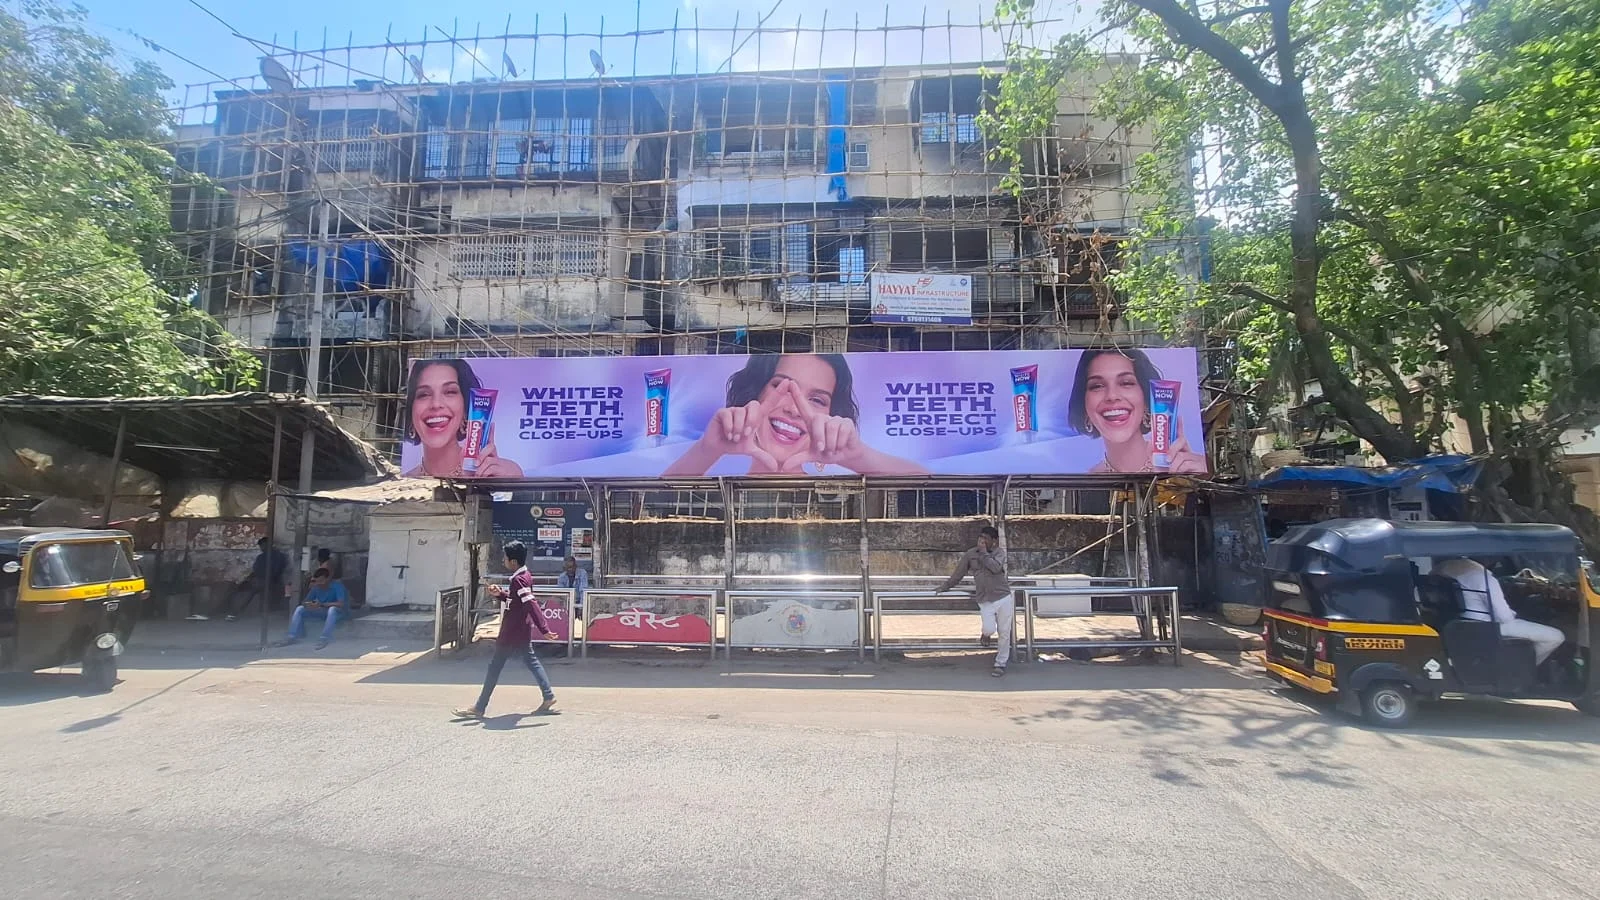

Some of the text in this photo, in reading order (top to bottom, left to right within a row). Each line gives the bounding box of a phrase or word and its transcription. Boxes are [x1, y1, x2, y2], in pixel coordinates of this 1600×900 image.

[879, 284, 917, 296] HAYYAT
[521, 387, 624, 399] WHITER
[885, 383, 995, 395] WHITER
[648, 400, 659, 433] closeup
[1017, 396, 1027, 429] closeup
[519, 417, 624, 430] PERFECT
[885, 413, 996, 425] PERFECT
[519, 430, 623, 440] CLOSE-UPS
[886, 427, 997, 437] CLOSE-UPS
[1155, 415, 1167, 451] closeup
[467, 421, 481, 456] closeup
[616, 607, 680, 630] बेस्ट
